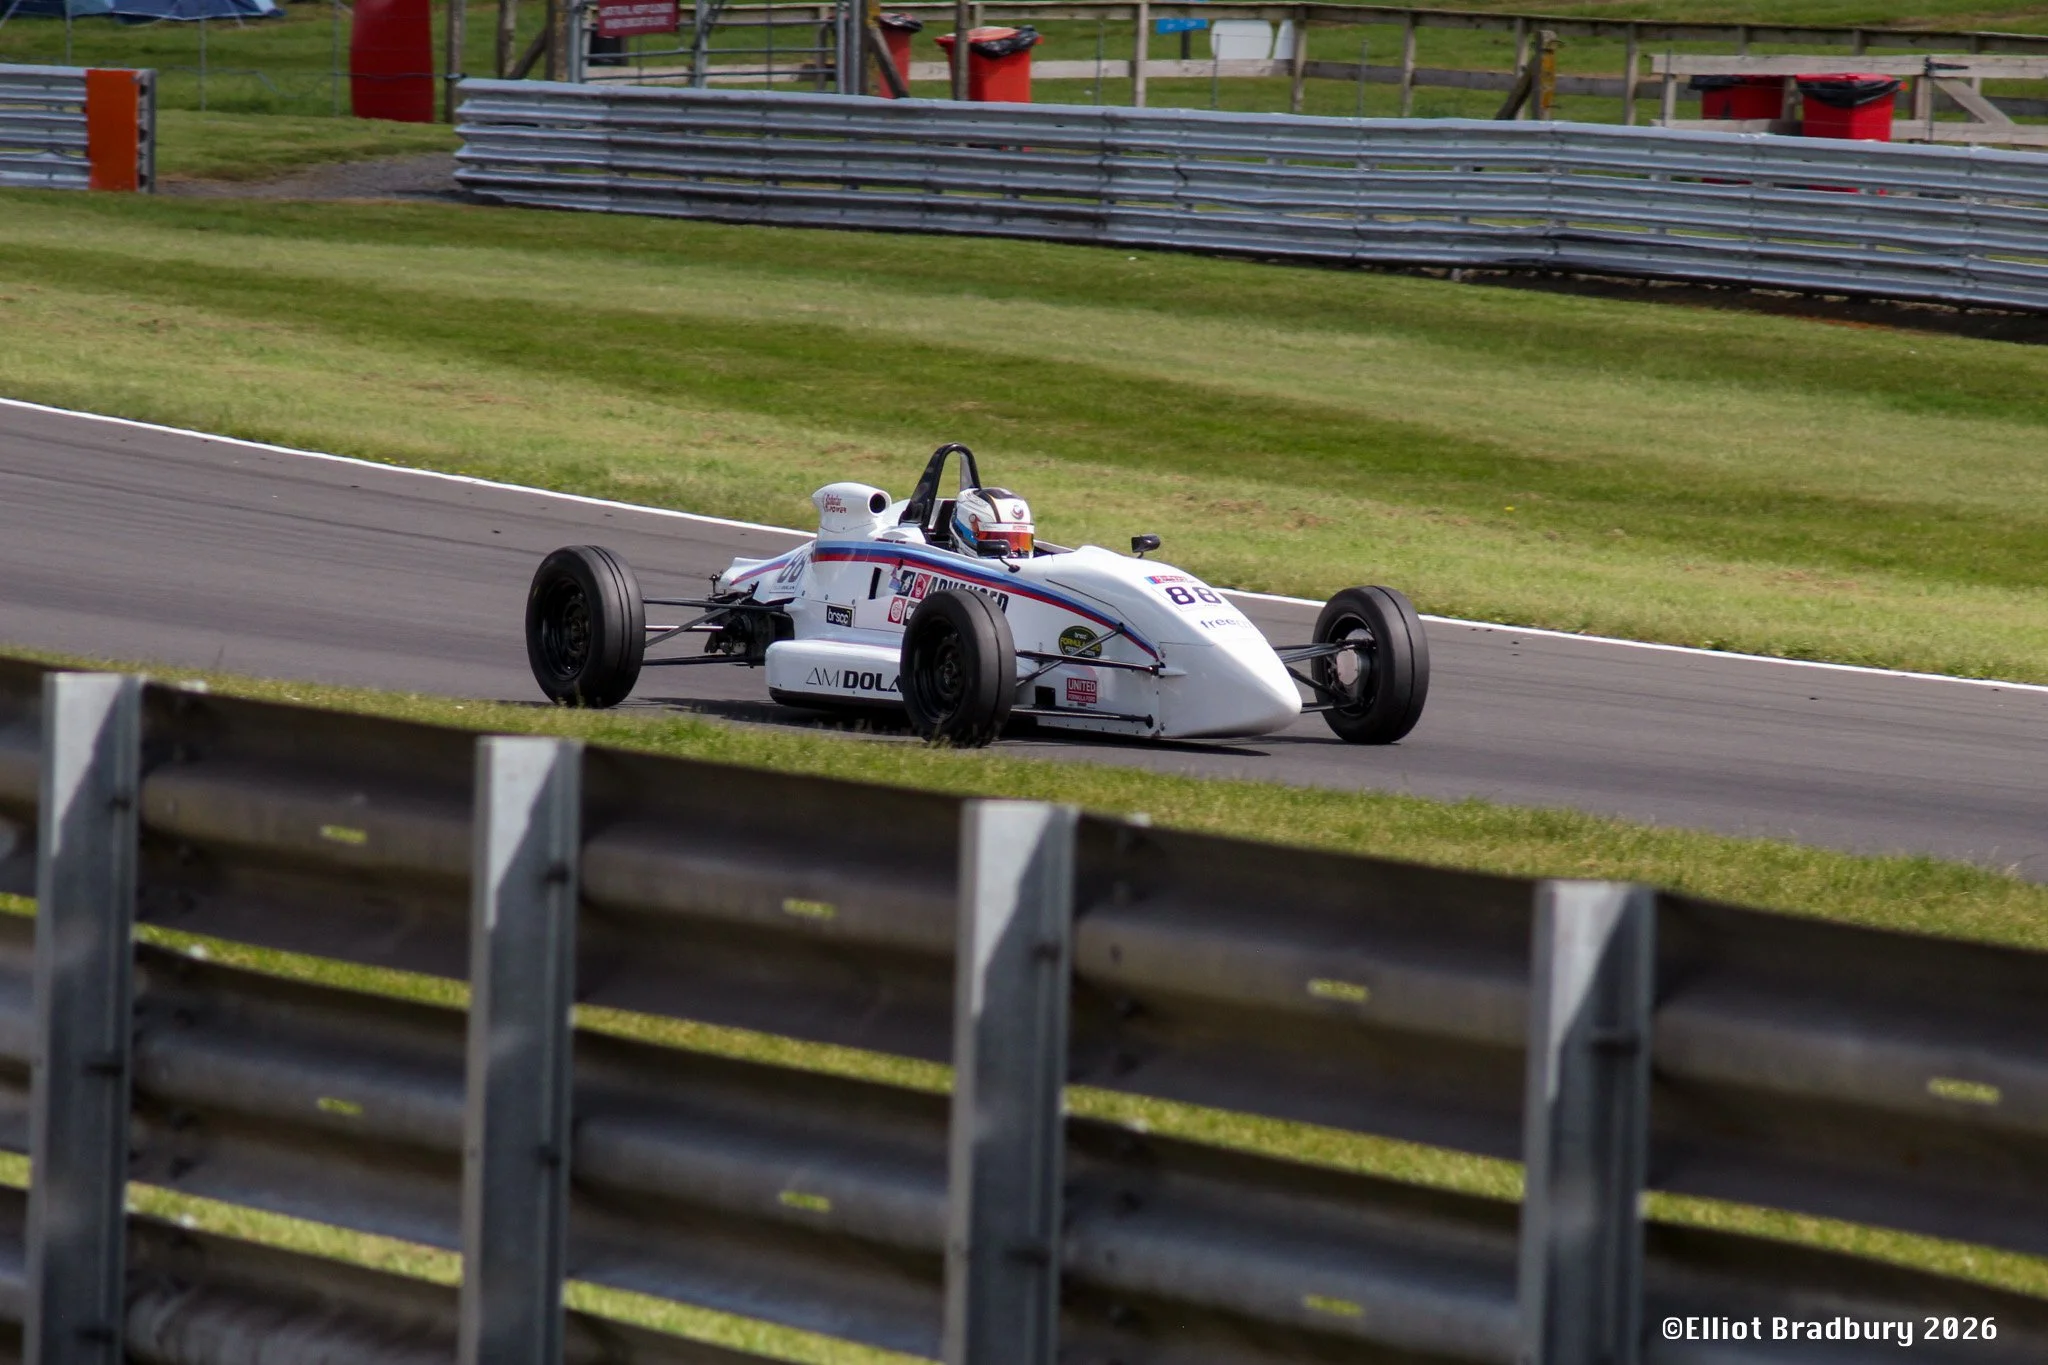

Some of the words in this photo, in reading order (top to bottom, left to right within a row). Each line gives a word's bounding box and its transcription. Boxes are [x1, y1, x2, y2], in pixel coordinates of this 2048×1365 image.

[928, 577, 1008, 613] ADVED
[1165, 586, 1222, 605] 88
[827, 608, 849, 624] brscc
[806, 667, 839, 688] AM
[1068, 678, 1096, 692] UNITED
